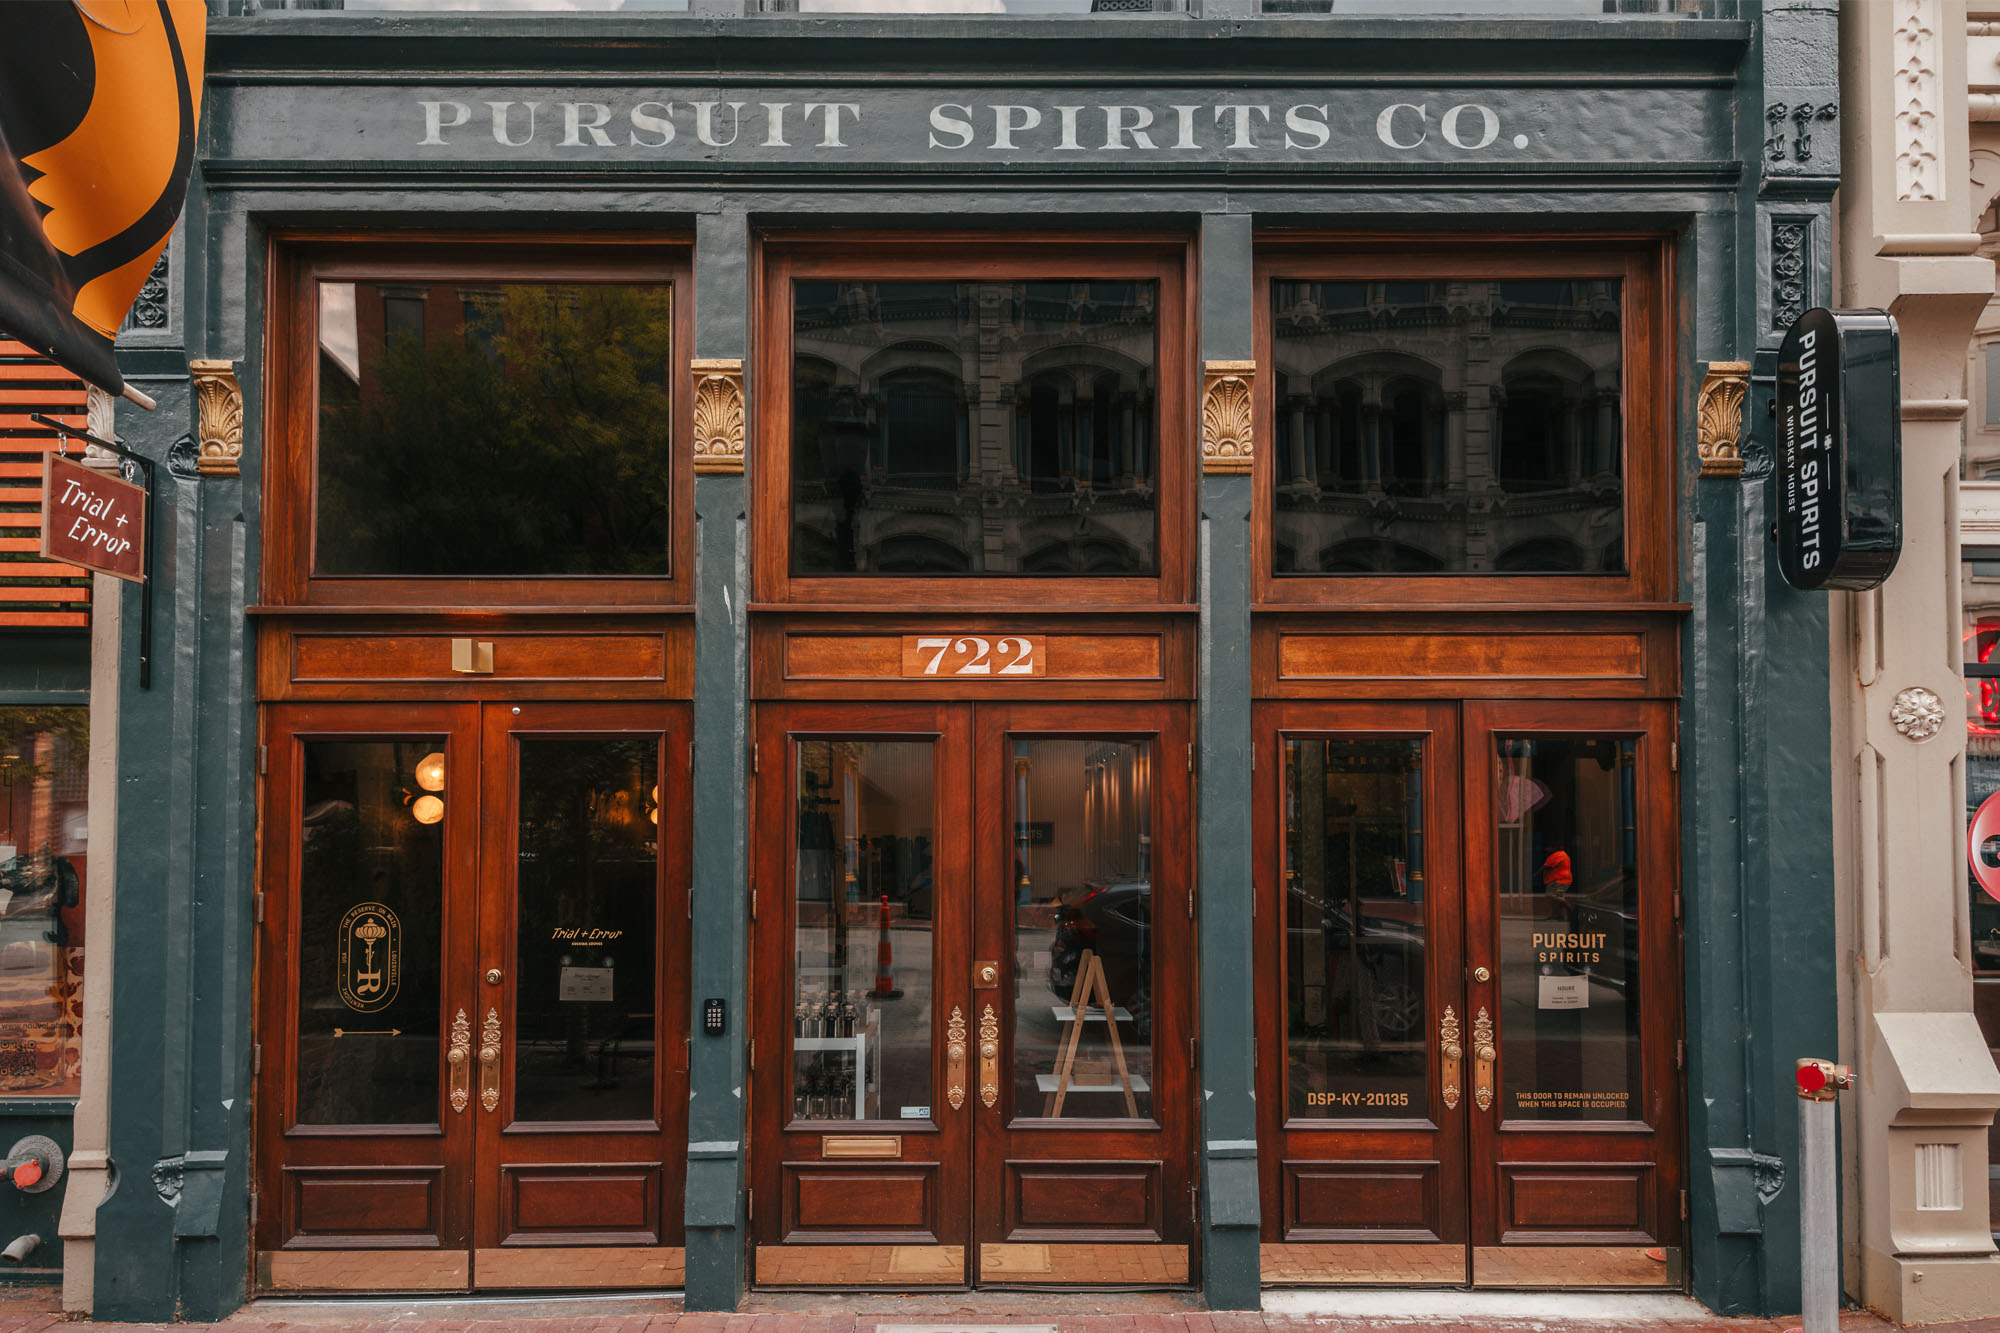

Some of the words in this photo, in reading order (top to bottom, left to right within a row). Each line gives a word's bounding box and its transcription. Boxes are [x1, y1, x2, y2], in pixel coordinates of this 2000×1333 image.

[416, 101, 860, 148] PURSUIT
[928, 103, 1331, 150] SPIRITS
[1375, 103, 1529, 150] CO.
[1799, 329, 1817, 450] PURSUIT
[1787, 405, 1793, 413] A
[1787, 415, 1795, 470] WHISKEY
[60, 479, 115, 520] Trial
[115, 514, 129, 528] +
[1788, 473, 1796, 513] HOUSE
[1801, 460, 1820, 570] SPIRITS
[68, 516, 130, 555] Error
[917, 637, 1033, 674] 722
[351, 905, 376, 918] RESERVE
[552, 927, 581, 939] Trial
[589, 928, 623, 939] Error
[1532, 933, 1607, 949] PURSUIT
[1539, 952, 1600, 963] SPIRITS
[1307, 1092, 1409, 1106] DSP-KY-20135
[1516, 1092, 1532, 1100] THIS
[1533, 1092, 1552, 1100] DOOR
[1553, 1092, 1563, 1100] TO
[1563, 1092, 1591, 1100] REMAIN
[1592, 1092, 1629, 1100] UNLOCKED
[1518, 1100, 1539, 1108] WHEN
[1541, 1100, 1556, 1108] THIS
[1558, 1100, 1581, 1108] SPACE
[1582, 1100, 1589, 1108] IS
